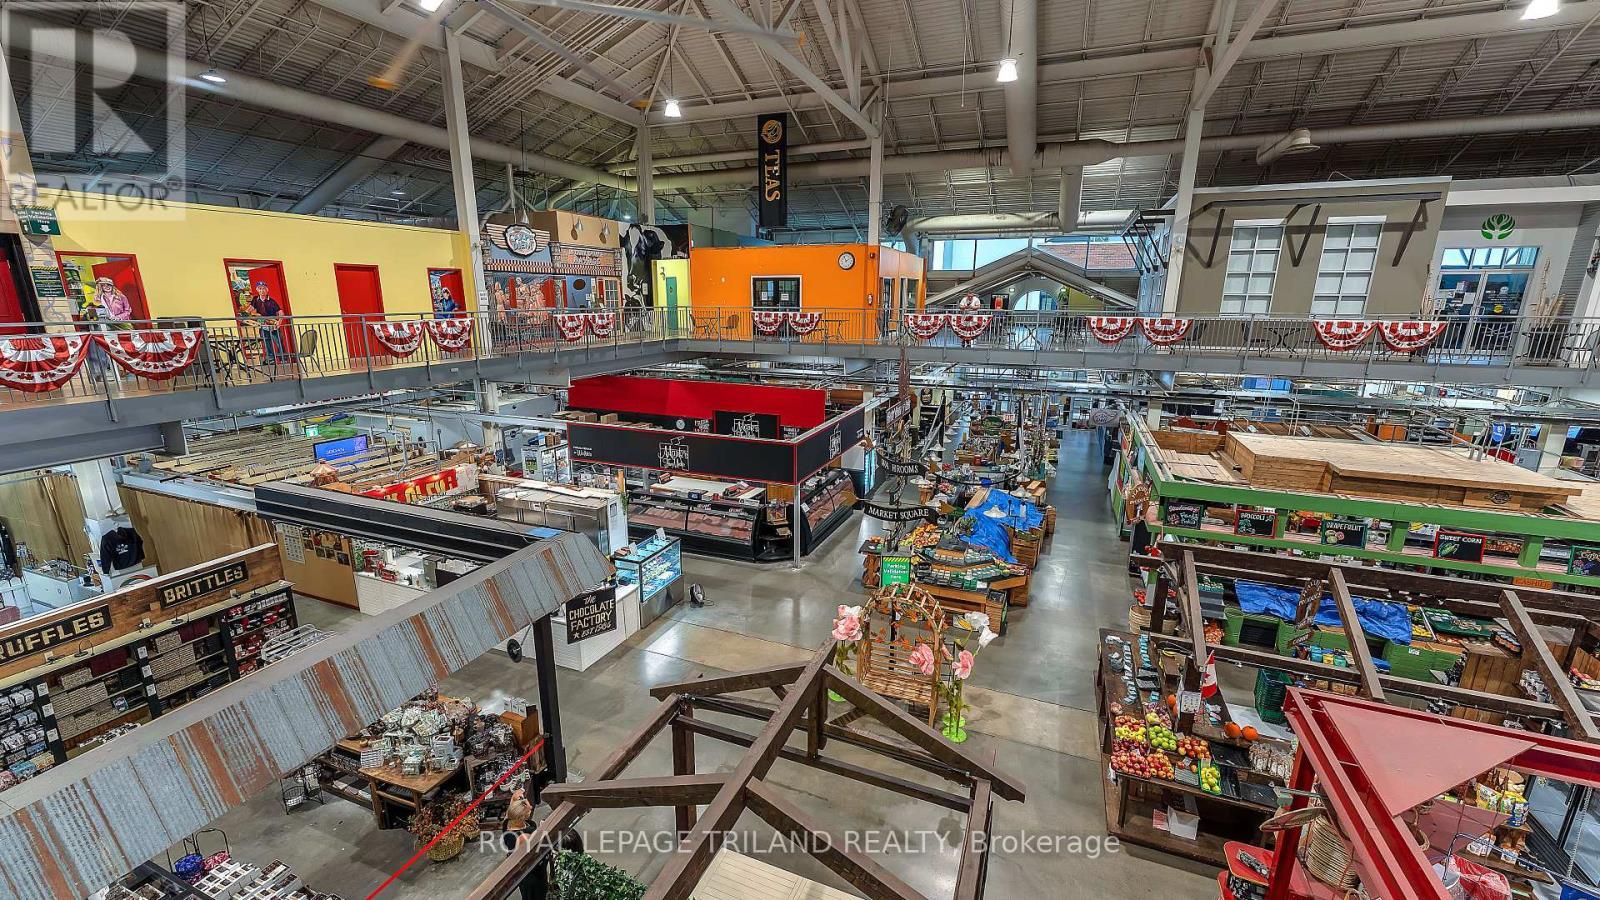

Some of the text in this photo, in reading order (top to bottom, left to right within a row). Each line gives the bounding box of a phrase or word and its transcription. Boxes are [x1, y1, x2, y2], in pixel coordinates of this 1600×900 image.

[764, 149, 781, 202] TEAS
[868, 506, 929, 520] MARKET SQUARE
[1240, 512, 1266, 521] BROCCOLI
[1440, 534, 1461, 542] SWEET
[164, 566, 244, 604] BRITTLES
[569, 598, 615, 621] CHOCOLATE
[570, 609, 613, 632] FACTORY
